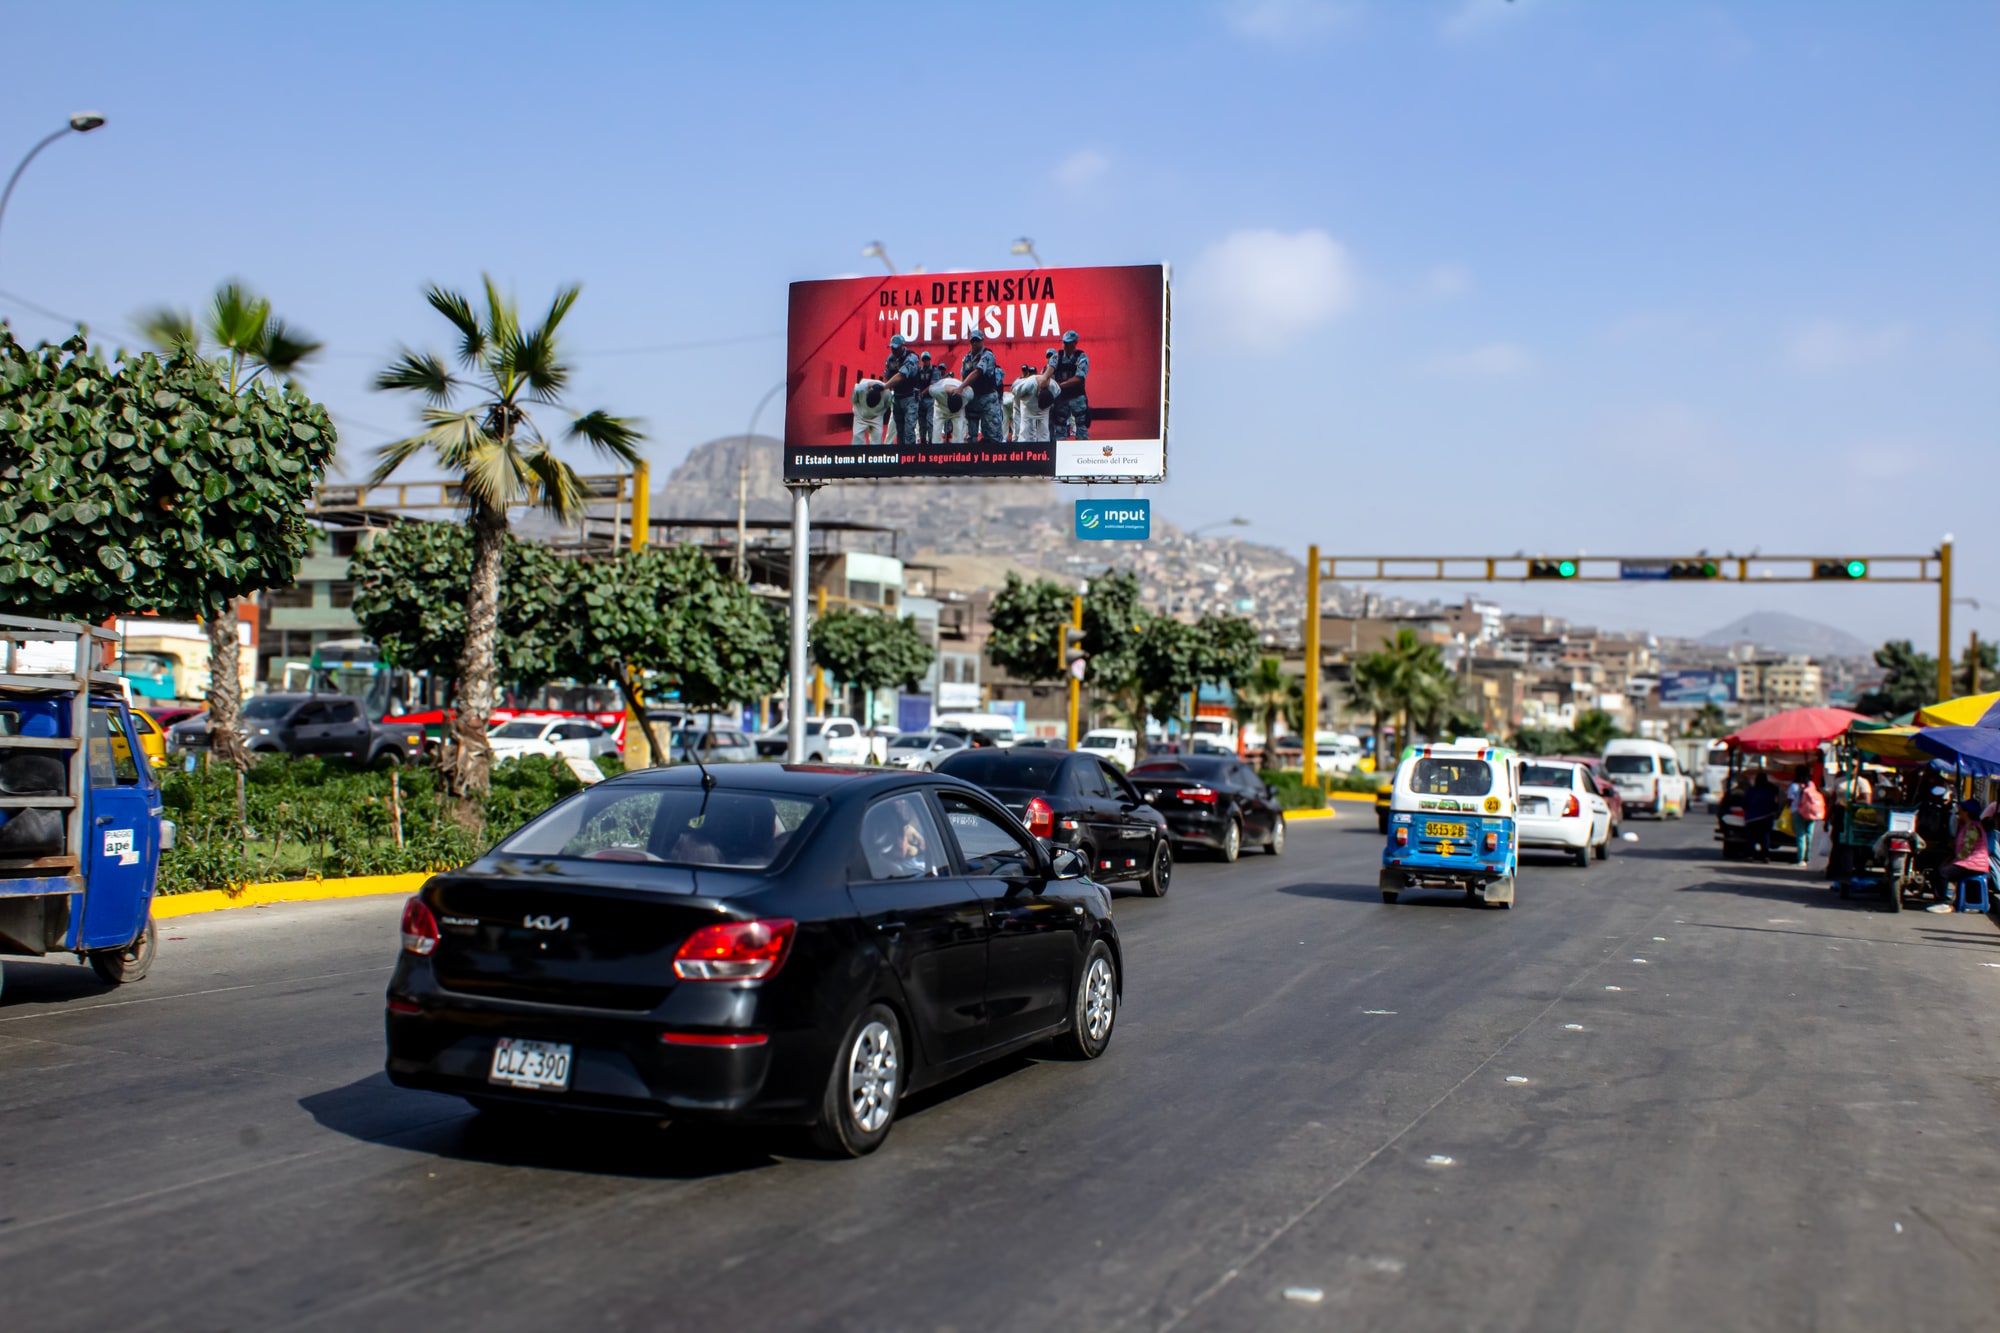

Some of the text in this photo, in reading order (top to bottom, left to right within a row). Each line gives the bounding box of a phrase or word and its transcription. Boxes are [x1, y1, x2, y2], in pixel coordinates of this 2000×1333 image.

[880, 277, 1055, 307] DE LA DEFENSIVA
[878, 302, 1061, 343] A LA OFENSIVA
[795, 451, 1050, 465] El Estado toma el control por la seguridad y la paz del Perú.
[1076, 456, 1138, 465] Gobierno del Perú
[1104, 509, 1145, 524] input
[1487, 801, 1499, 811] 23
[497, 1048, 567, 1080] CLZ-390
